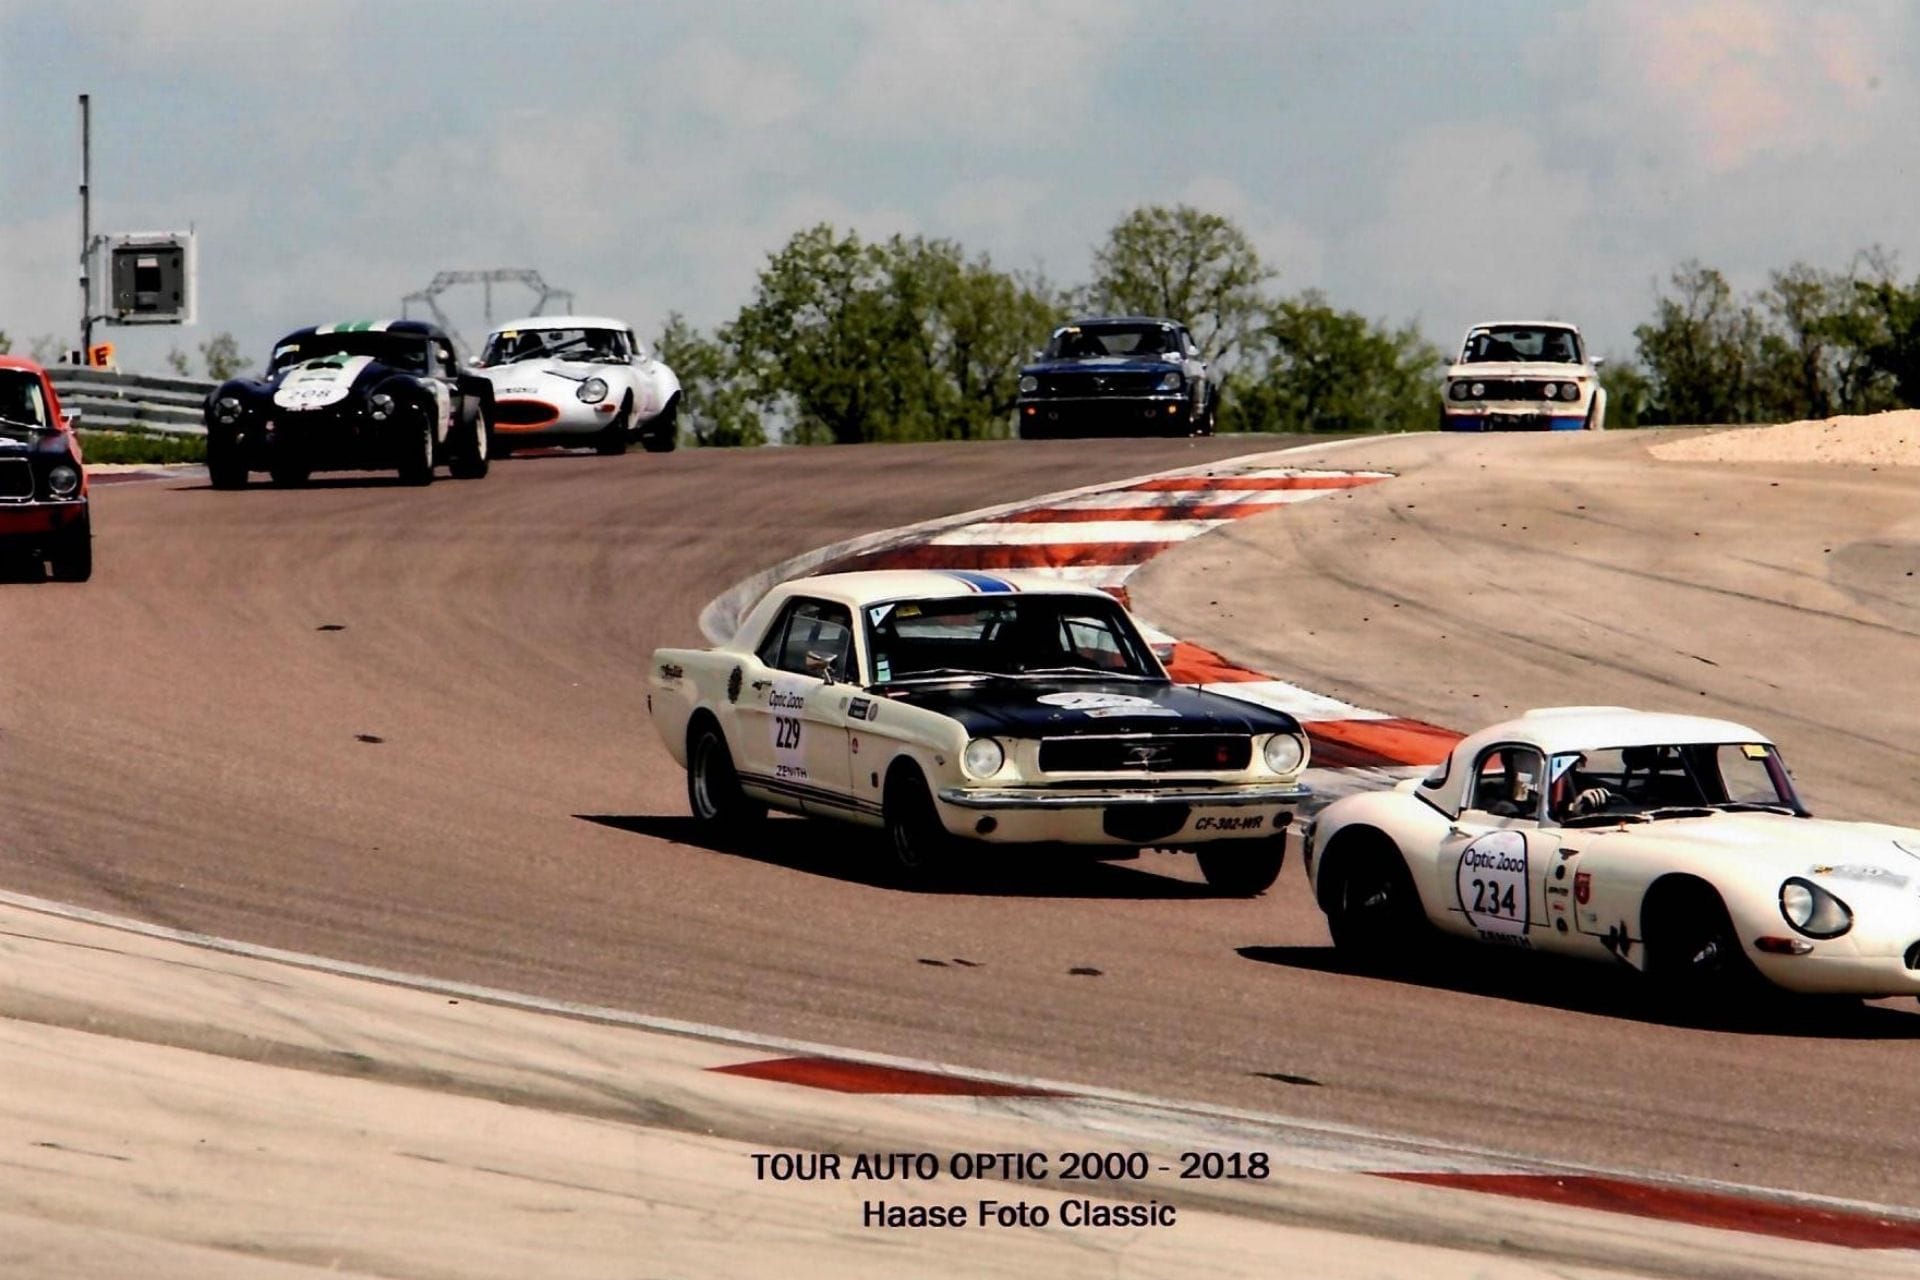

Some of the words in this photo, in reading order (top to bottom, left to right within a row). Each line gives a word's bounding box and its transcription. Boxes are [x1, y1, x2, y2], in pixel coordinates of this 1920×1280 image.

[776, 717, 801, 749] 229
[776, 765, 808, 779] ZENITH
[1465, 848, 1496, 872] Optic
[1496, 852, 1526, 873] 2000
[1472, 879, 1517, 917] 234
